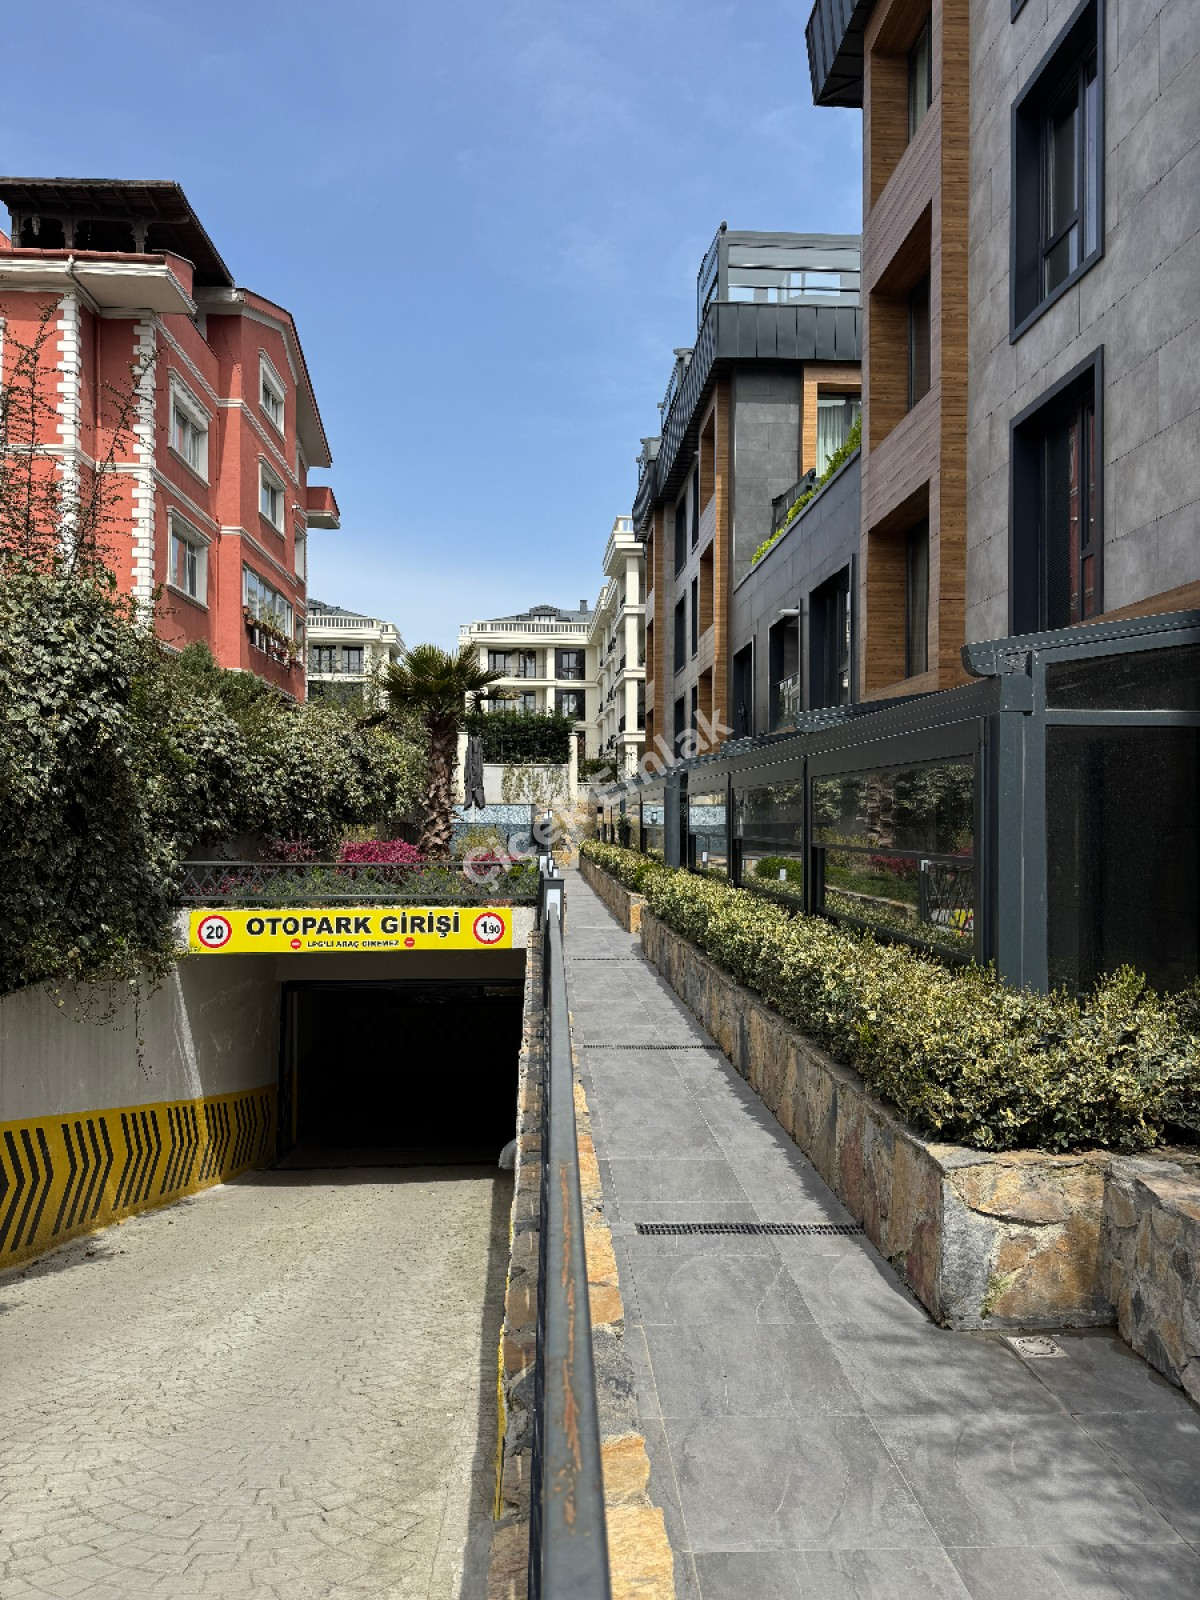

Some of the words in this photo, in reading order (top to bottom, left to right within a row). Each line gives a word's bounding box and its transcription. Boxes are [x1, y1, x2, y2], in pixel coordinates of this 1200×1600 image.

[246, 916, 372, 936] OTOPARK
[380, 911, 460, 938] GİRİŞİ
[206, 925, 224, 940] 20
[336, 940, 359, 949] ARAÇ
